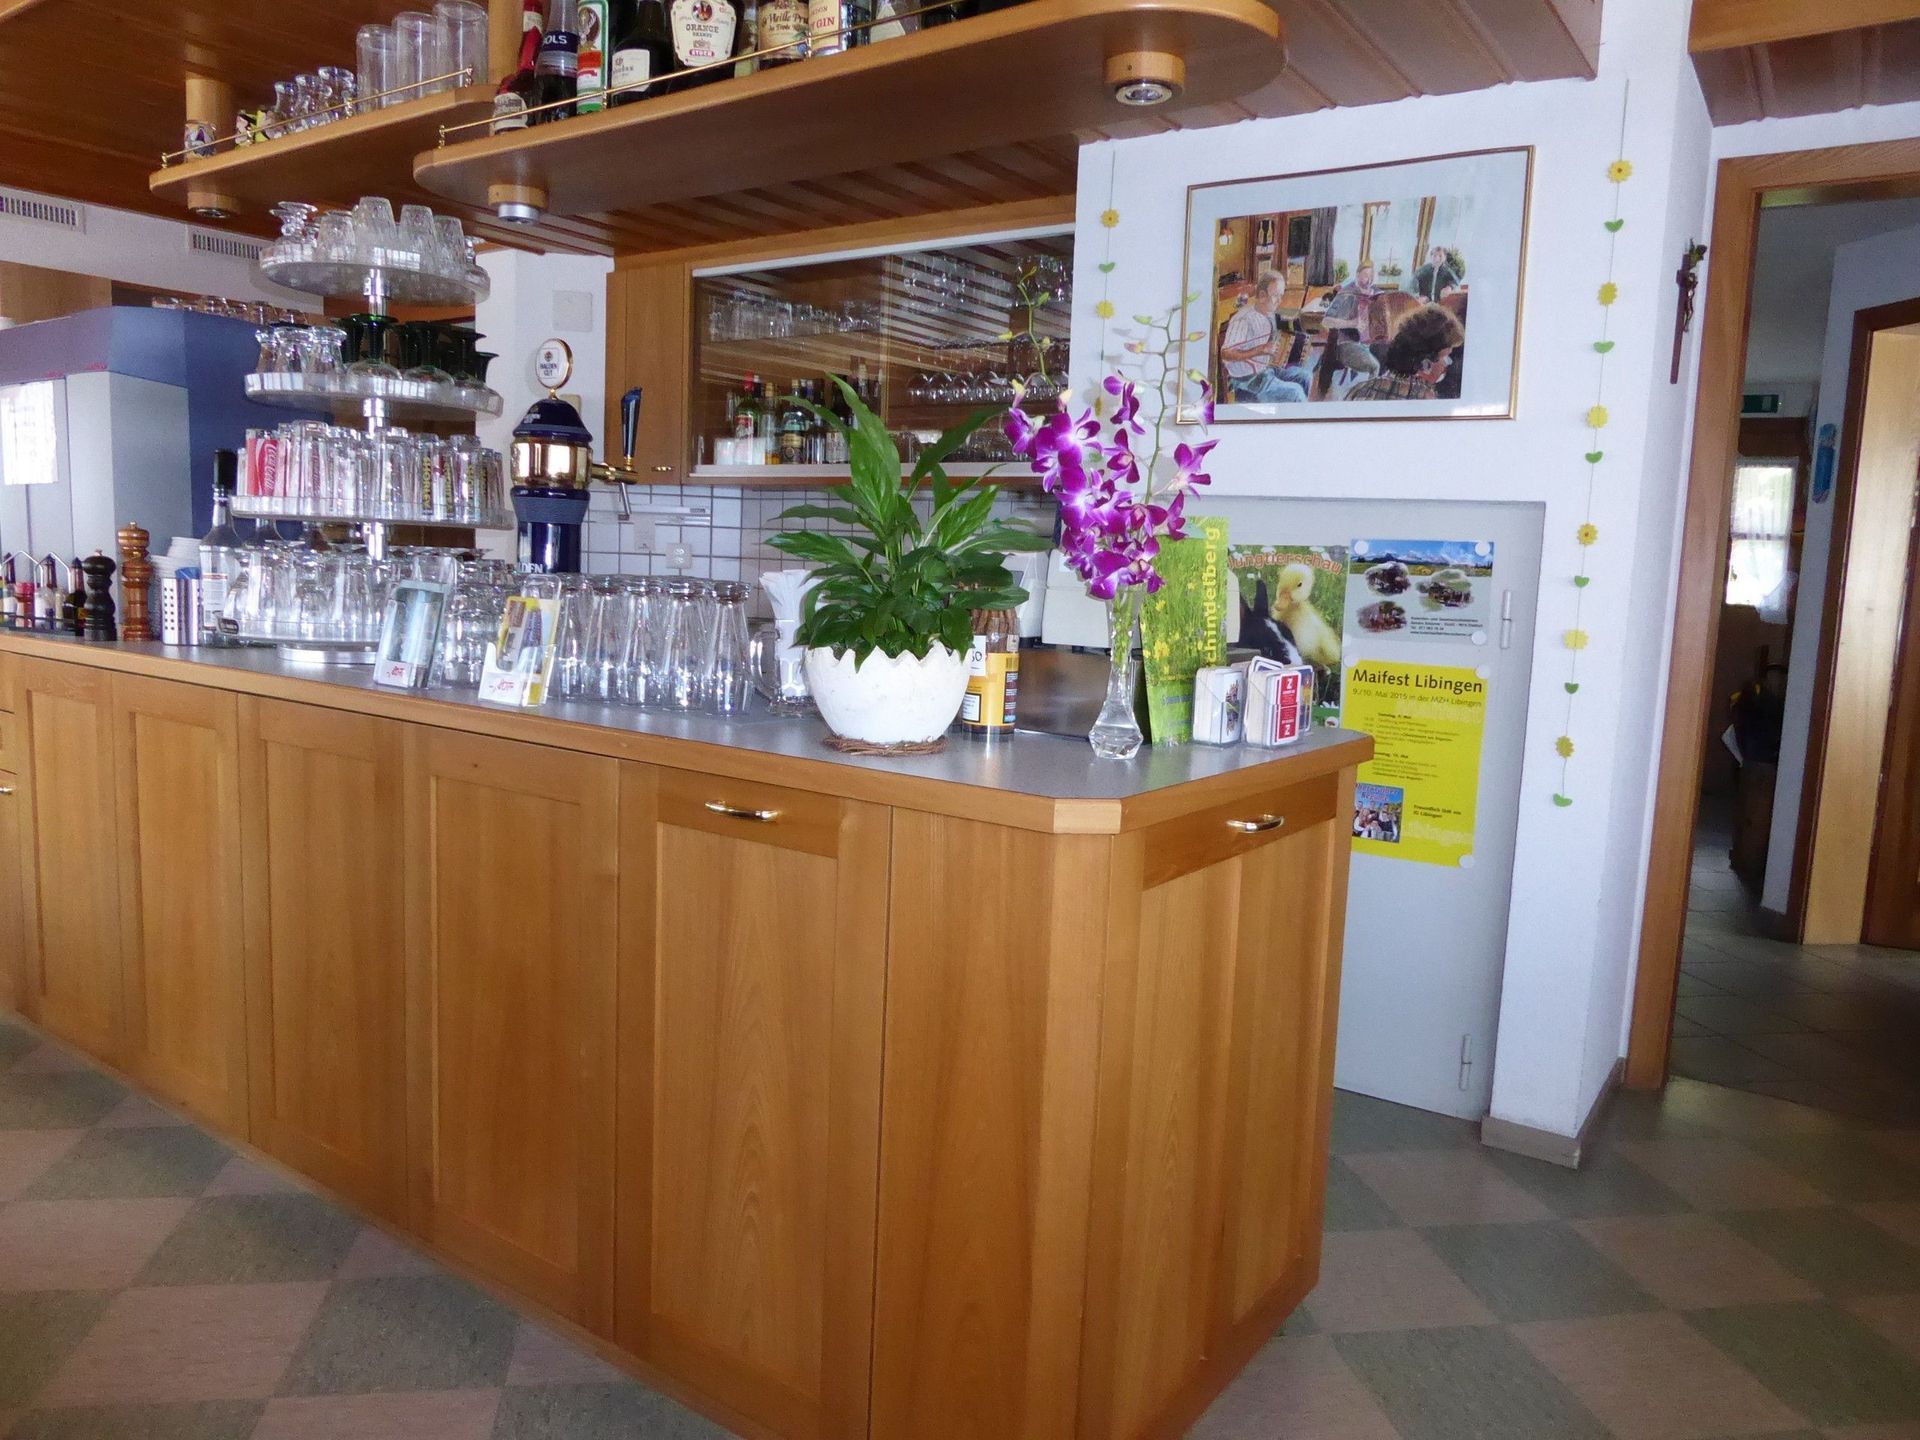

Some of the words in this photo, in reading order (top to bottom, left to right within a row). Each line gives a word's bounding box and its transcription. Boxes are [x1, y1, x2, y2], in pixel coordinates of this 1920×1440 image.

[685, 23, 719, 33] ORANGE
[816, 17, 835, 29] GIN
[1228, 552, 1342, 575] Jungtierschau
[1203, 527, 1220, 667] chindelberg
[1286, 678, 1293, 689] Z
[1353, 669, 1410, 686] Maifest
[1415, 674, 1482, 695] Libingen
[1390, 692, 1407, 700] 2015
[1451, 698, 1482, 708] Libingen
